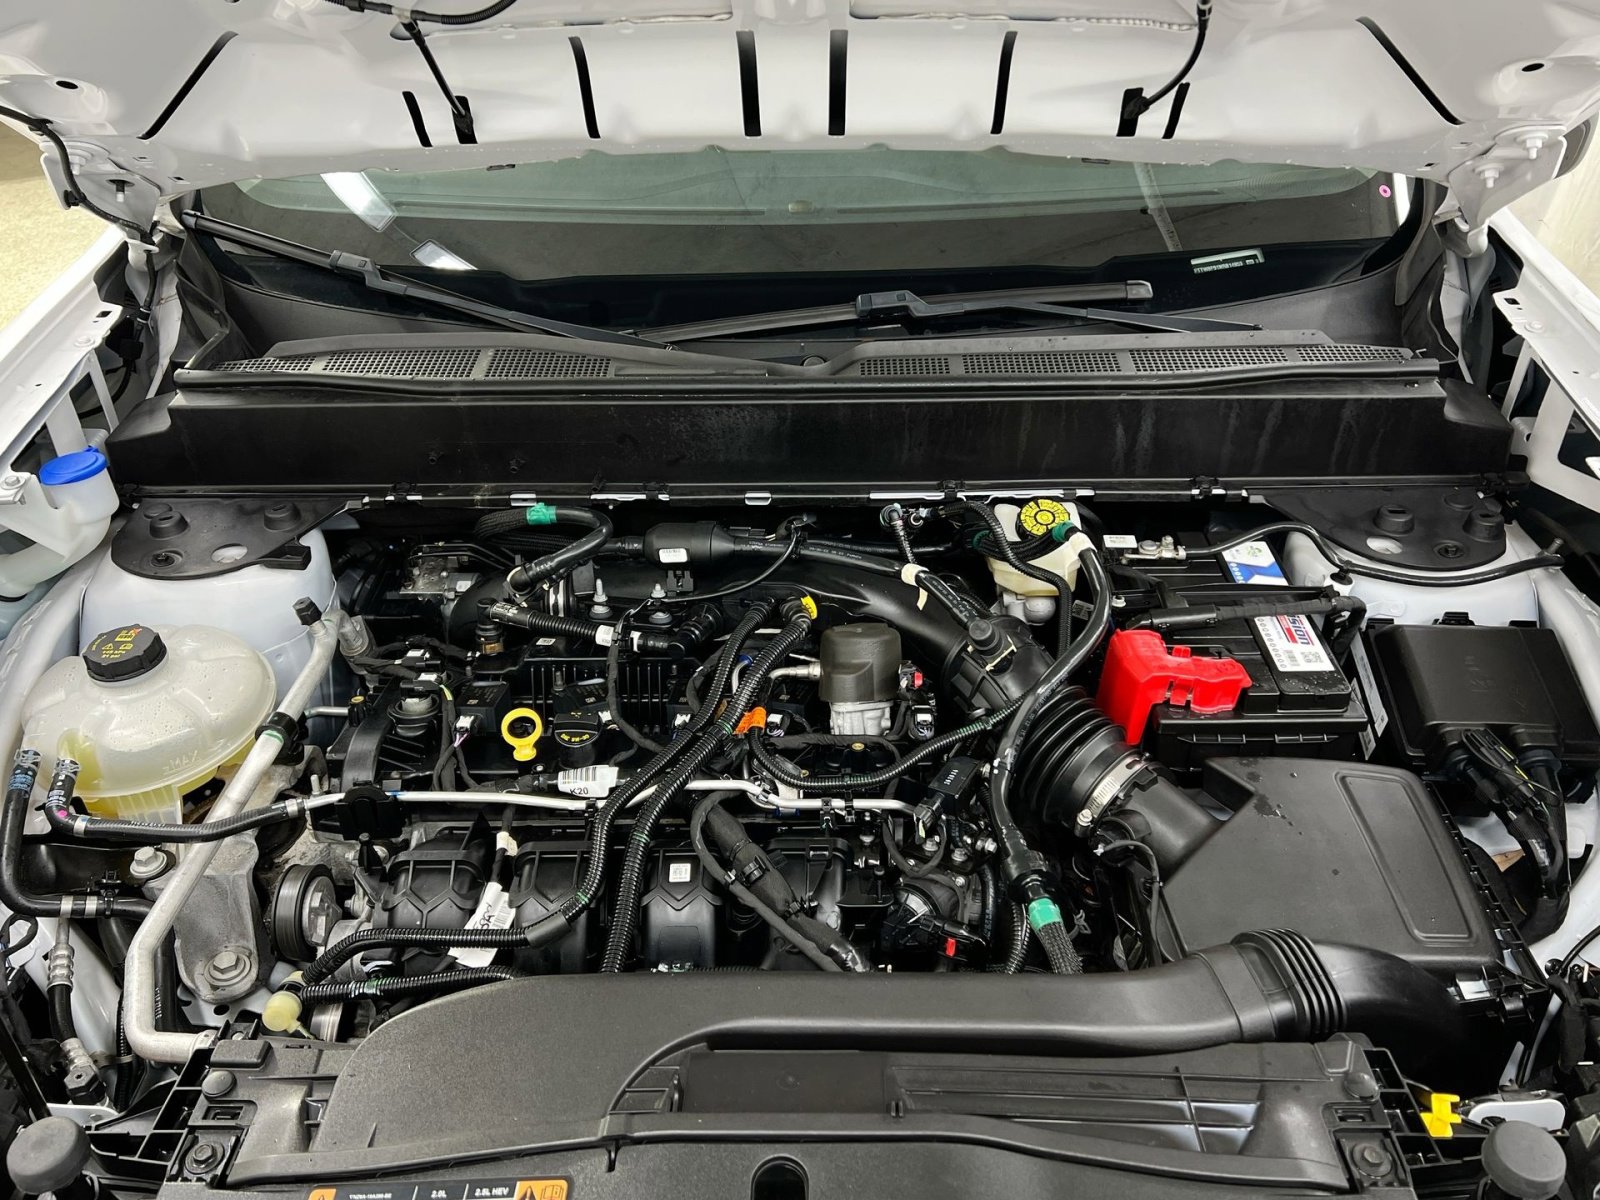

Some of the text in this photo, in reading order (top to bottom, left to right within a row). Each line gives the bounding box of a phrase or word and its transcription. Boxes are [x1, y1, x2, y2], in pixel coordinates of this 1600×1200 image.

[569, 787, 589, 796] K20
[431, 1189, 447, 1199] 2.0L
[491, 1186, 509, 1196] HEV
